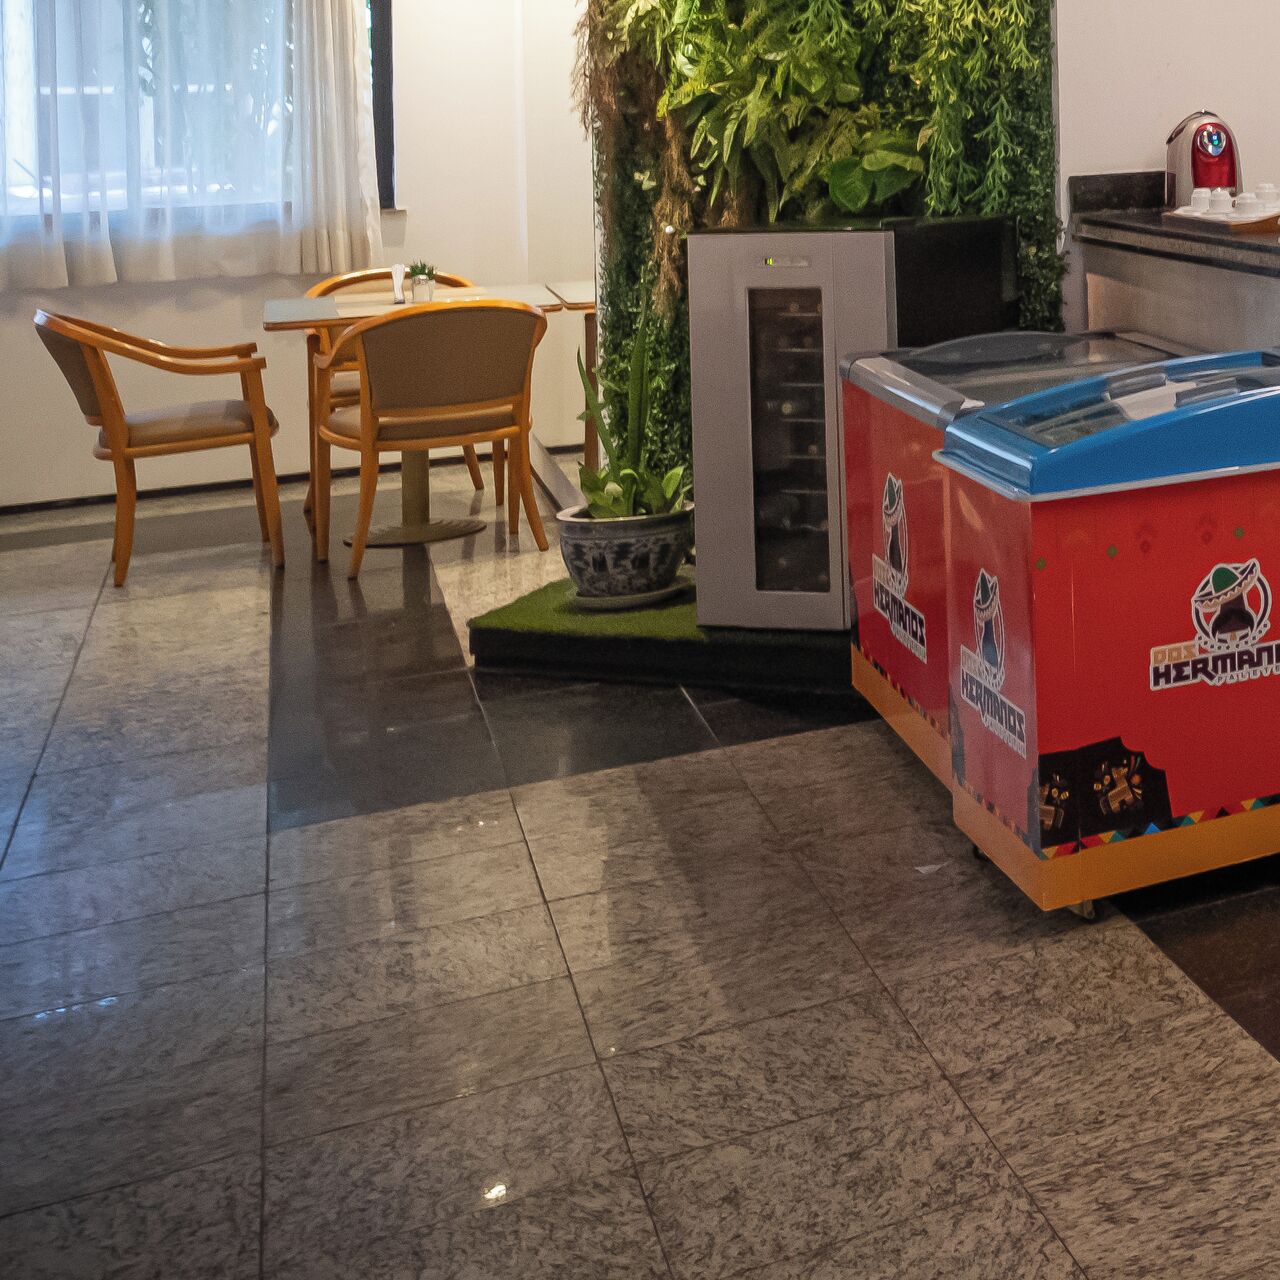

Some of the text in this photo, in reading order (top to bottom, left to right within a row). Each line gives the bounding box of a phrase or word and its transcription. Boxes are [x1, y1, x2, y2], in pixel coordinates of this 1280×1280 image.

[874, 578, 925, 648] HERMANOS
[1153, 644, 1197, 665] DOS
[961, 668, 1025, 743] HERMANOS
